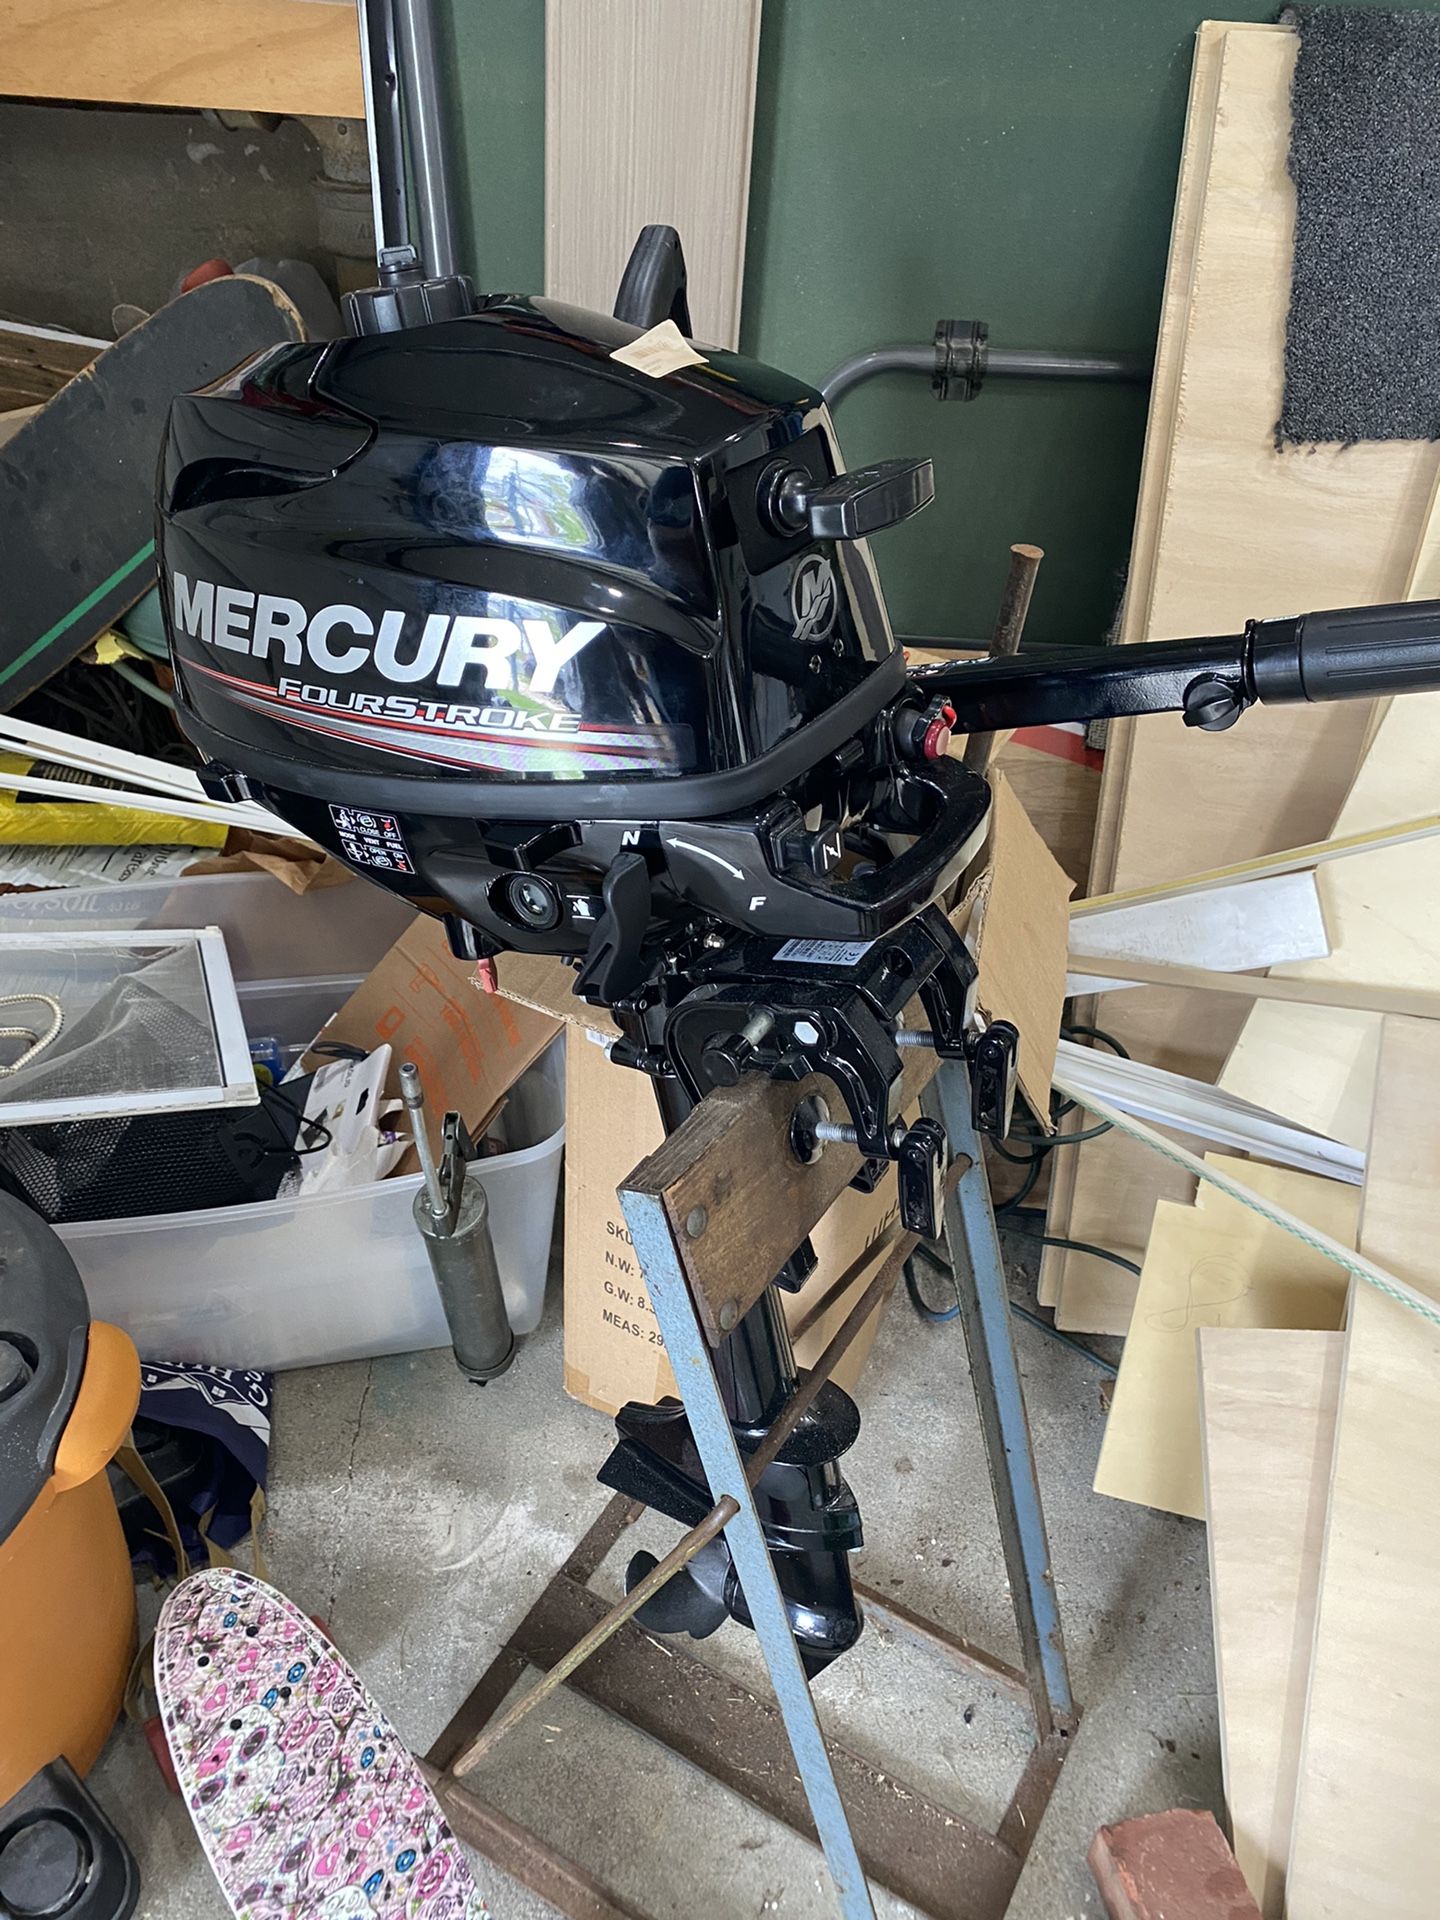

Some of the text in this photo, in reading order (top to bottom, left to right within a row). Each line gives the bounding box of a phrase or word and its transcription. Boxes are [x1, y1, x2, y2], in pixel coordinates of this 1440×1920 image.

[173, 571, 607, 693] MERCURY
[386, 841, 404, 851] FUEL
[621, 830, 641, 846] N
[749, 896, 767, 911] F
[605, 1250, 635, 1277] N.W:
[603, 1280, 634, 1306] G.W:
[602, 1308, 645, 1339] MEAS:
